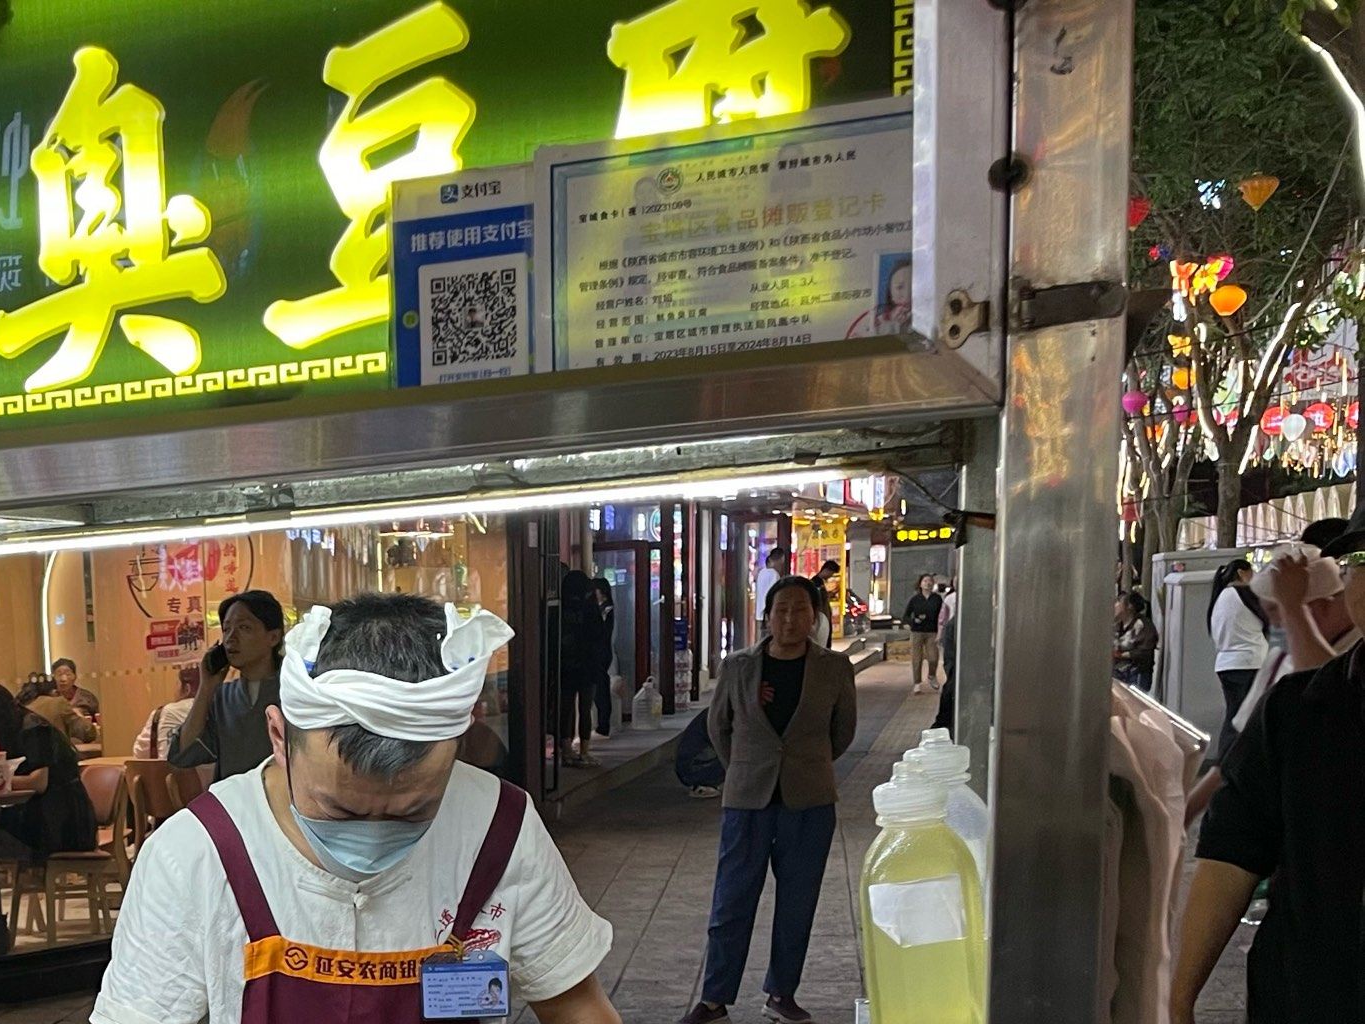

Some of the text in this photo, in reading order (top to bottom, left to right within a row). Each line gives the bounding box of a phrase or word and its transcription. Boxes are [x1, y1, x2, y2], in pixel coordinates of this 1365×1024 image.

[461, 181, 502, 200] 支付宝
[410, 219, 534, 253] 推荐使用支付宝
[316, 956, 425, 980] 延安农商银
